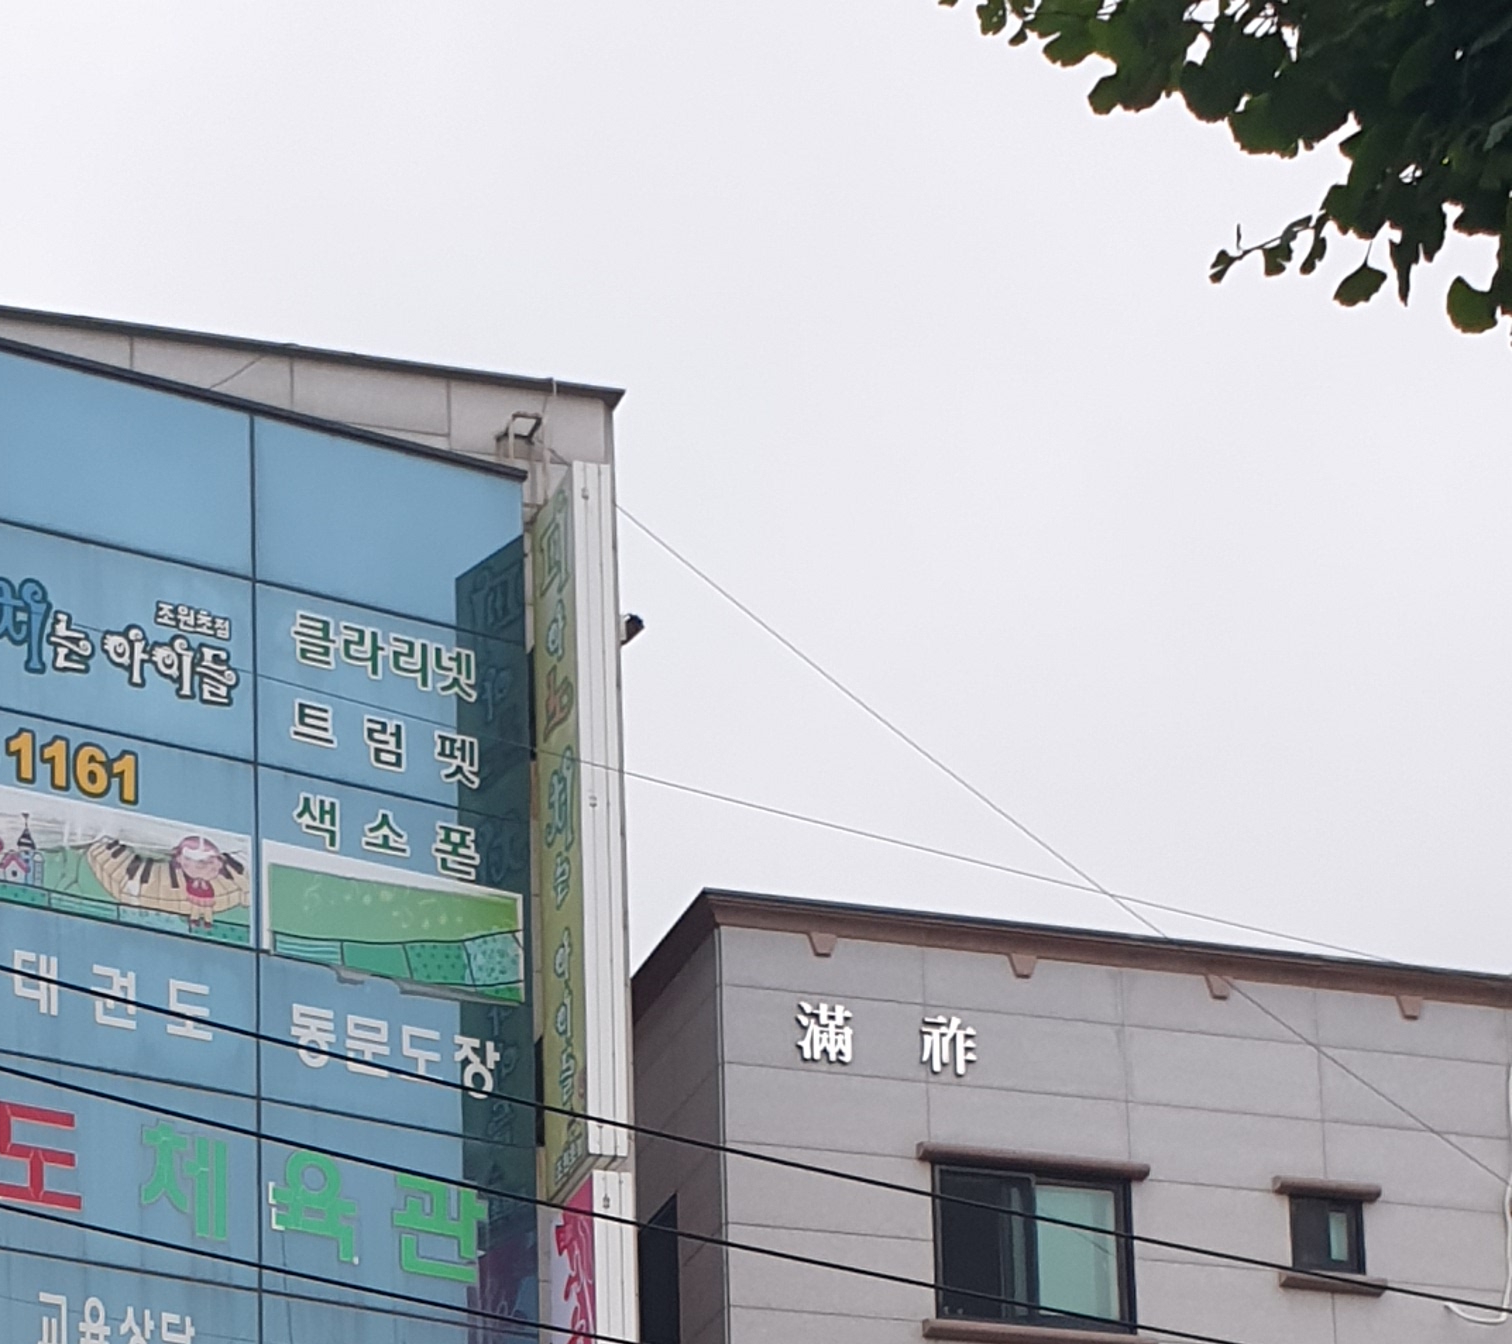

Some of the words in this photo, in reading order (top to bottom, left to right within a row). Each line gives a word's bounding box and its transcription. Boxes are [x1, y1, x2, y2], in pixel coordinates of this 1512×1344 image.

[103, 626, 240, 707] 아이들
[155, 600, 232, 640] 조원초점
[289, 610, 479, 703] 클라리넷
[291, 1003, 501, 1099] 동문도장
[140, 1119, 488, 1284] 체육관
